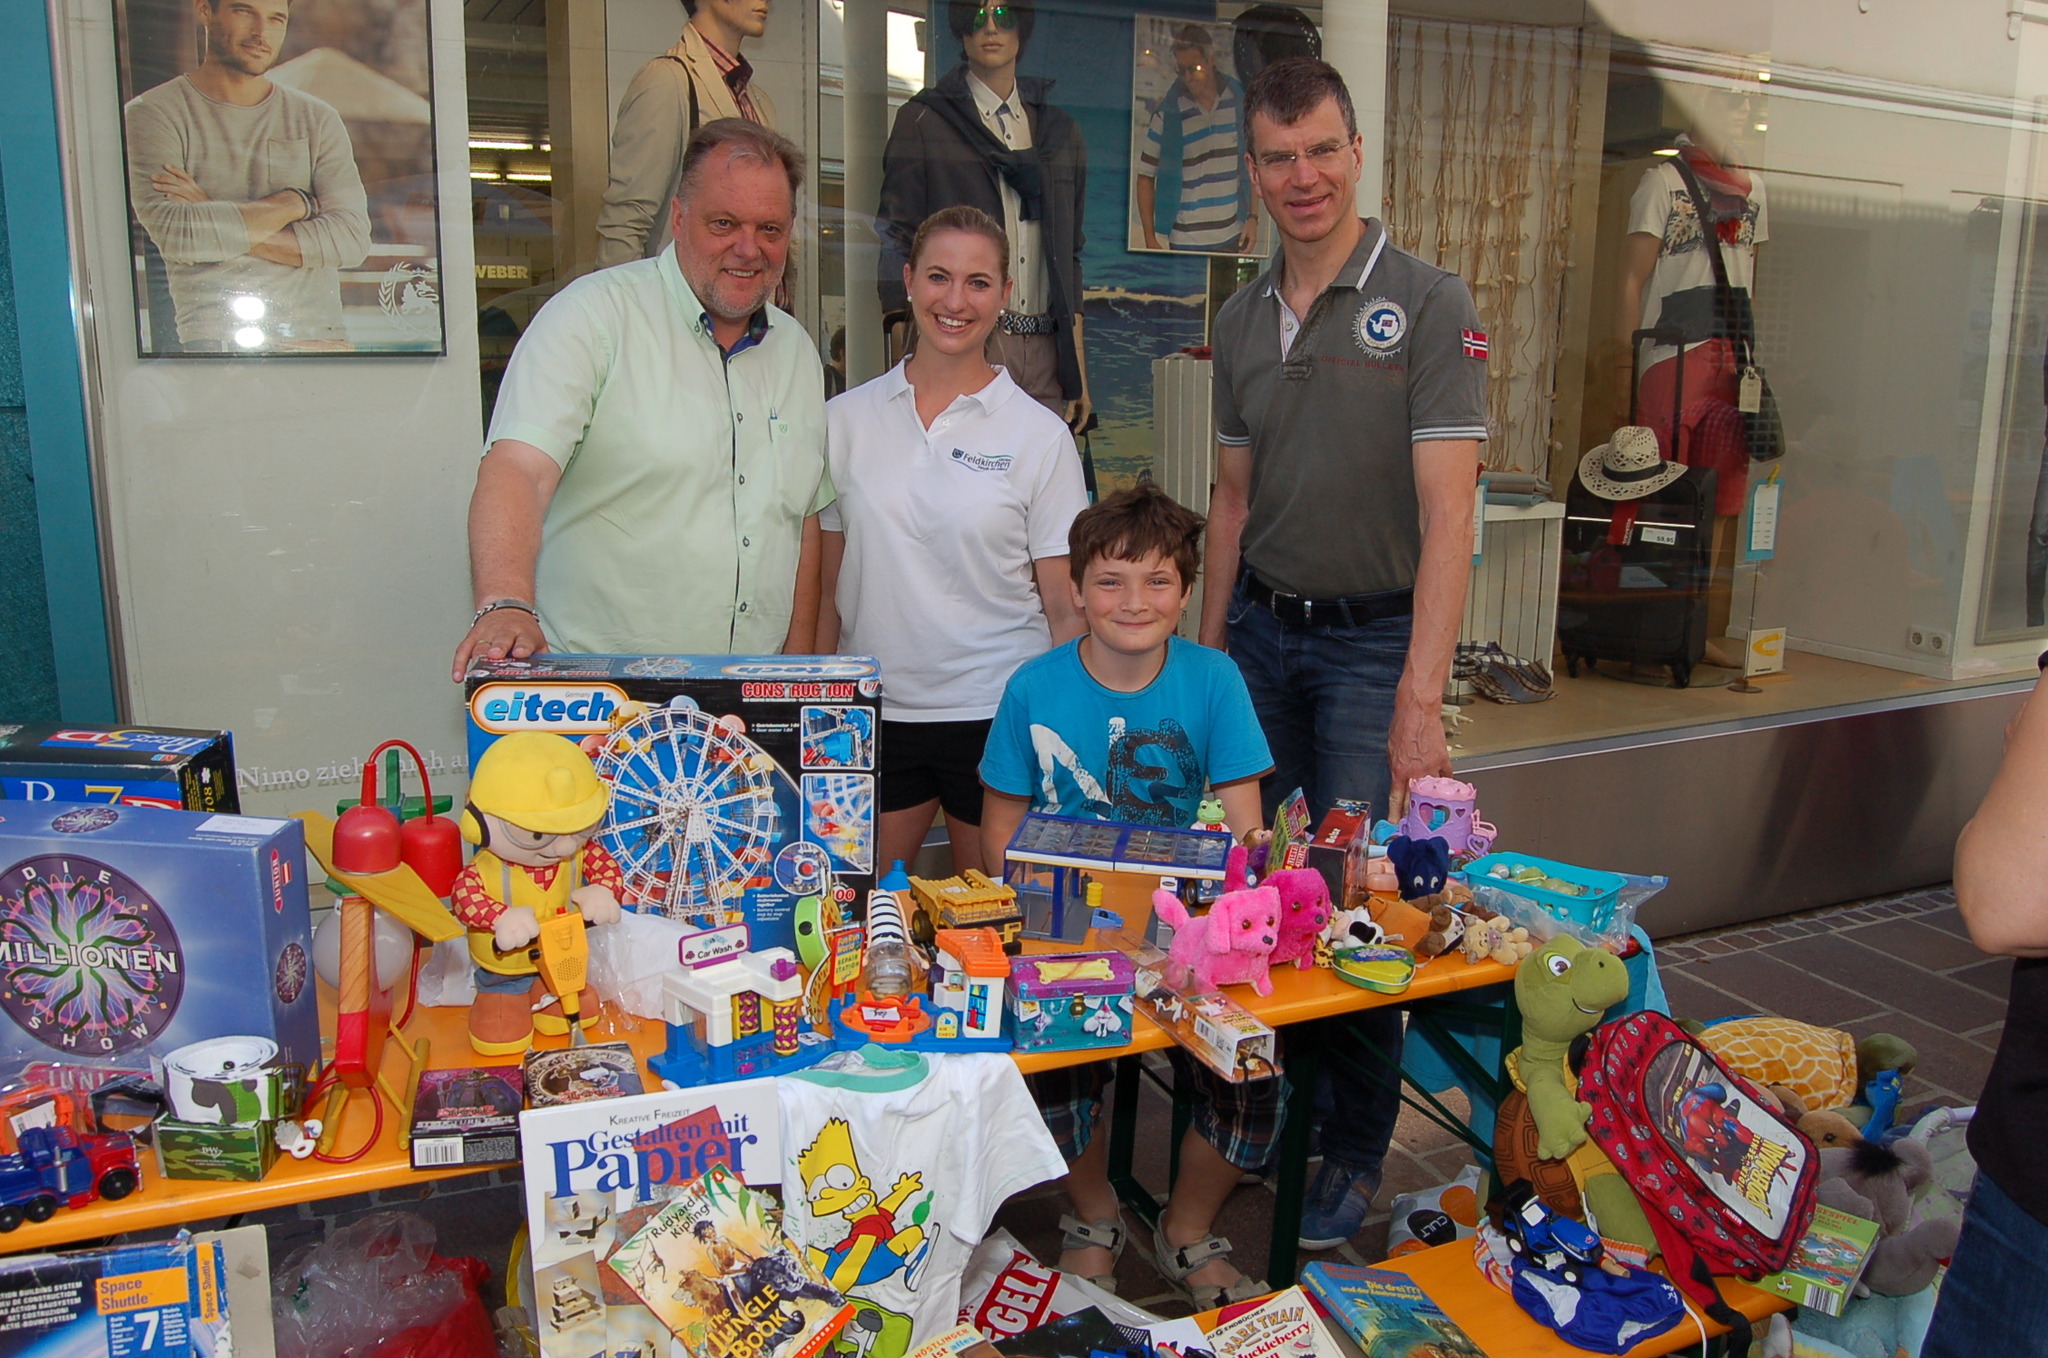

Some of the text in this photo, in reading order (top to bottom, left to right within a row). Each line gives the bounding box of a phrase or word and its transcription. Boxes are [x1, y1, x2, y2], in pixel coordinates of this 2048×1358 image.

[475, 264, 529, 279] WEBER
[962, 453, 1011, 469] Feldkirchen
[565, 690, 591, 700] Germany
[741, 681, 857, 700] CONSTRUCTION
[484, 691, 615, 722] eitech
[237, 765, 310, 788] Nimo
[316, 756, 379, 781] zieh
[451, 757, 468, 768] a
[22, 861, 112, 885] DIE
[272, 856, 283, 903] JUNIOR
[833, 888, 855, 902] 00
[697, 943, 733, 960] Car Wash
[28, 1015, 149, 1051] SHOW
[609, 1107, 691, 1126] KREATIVE FREIZEIT
[587, 1113, 749, 1153] Gestalten mit
[545, 1133, 758, 1203] Papier
[650, 1197, 698, 1239] Rudyard
[669, 1201, 711, 1240] Kipling
[1420, 1215, 1448, 1238] CULT
[19, 1286, 53, 1297] BUILDING
[54, 1281, 83, 1292] SYSTEM
[100, 1278, 143, 1296] Space
[201, 1260, 214, 1319] Space Shuttle
[1365, 1280, 1385, 1290] Die
[9, 1303, 37, 1315] ACTION
[38, 1297, 82, 1311] BAUSYSTEM
[23, 1290, 77, 1304] CONSTRUCTION
[101, 1293, 149, 1312] Shuttle
[707, 1306, 733, 1330] The
[133, 1310, 160, 1352] 7
[1220, 1305, 1306, 1356] MARK TWAIN
[950, 1335, 977, 1351] alles
